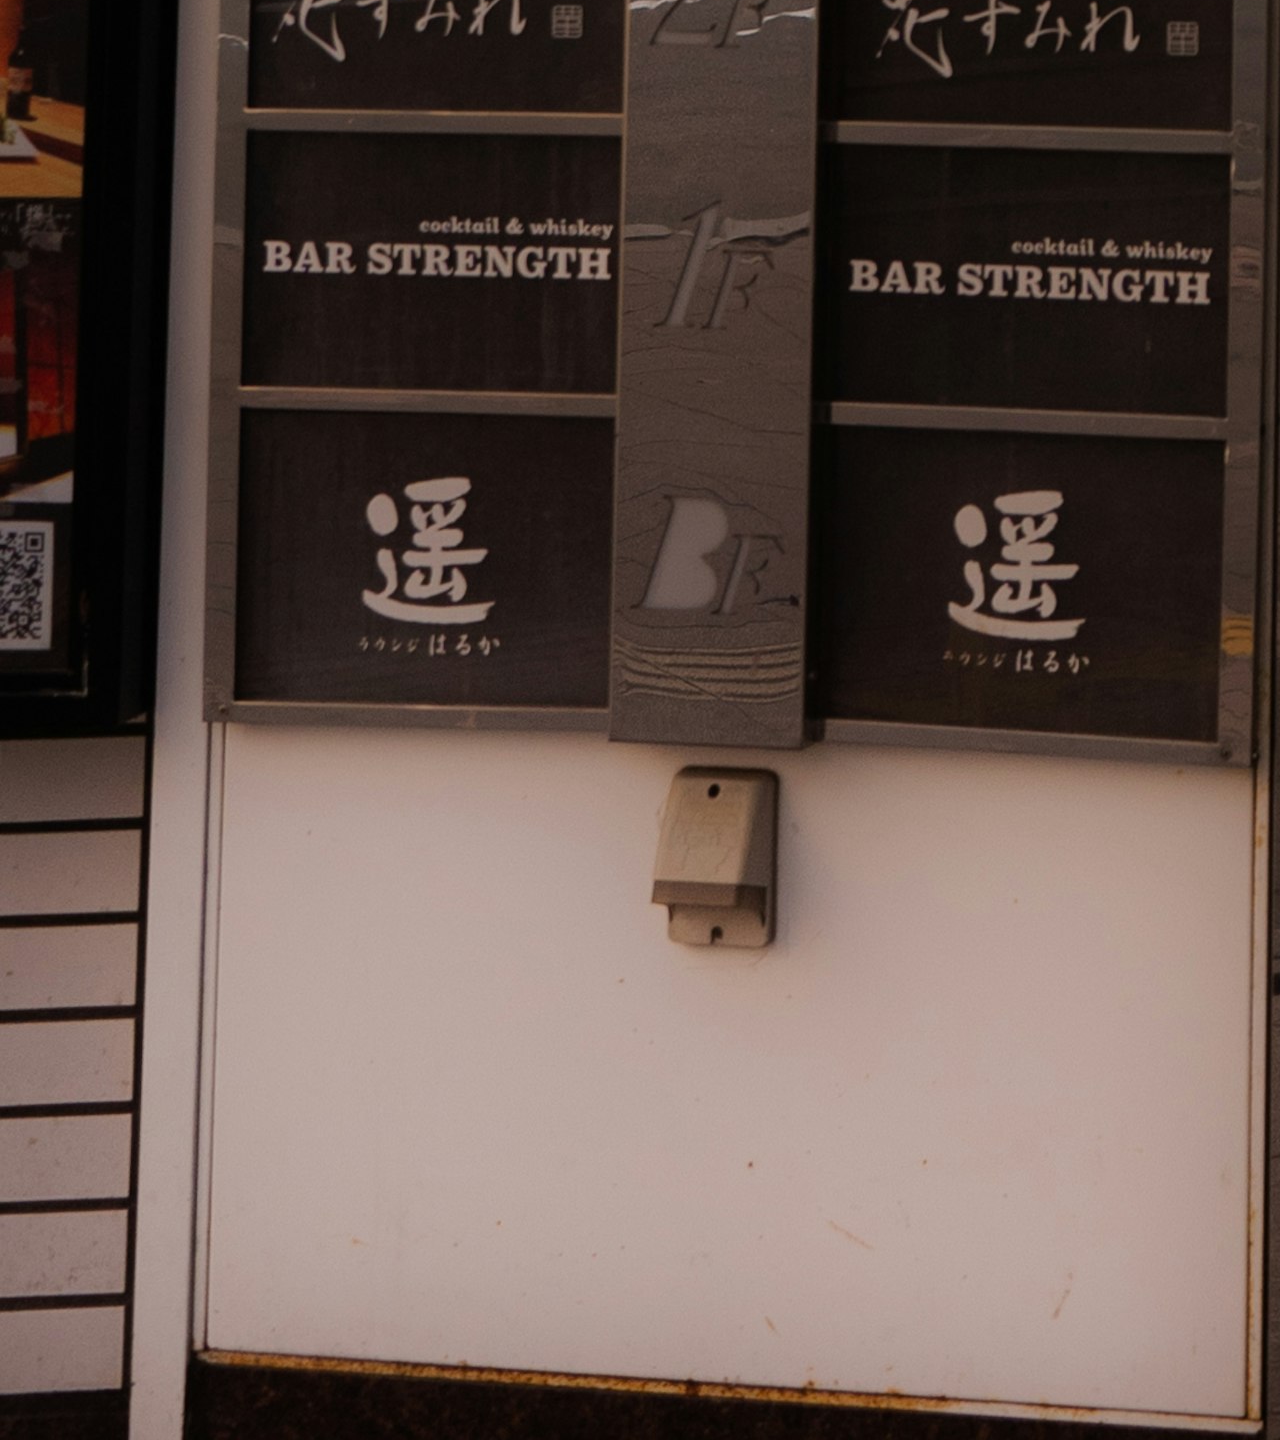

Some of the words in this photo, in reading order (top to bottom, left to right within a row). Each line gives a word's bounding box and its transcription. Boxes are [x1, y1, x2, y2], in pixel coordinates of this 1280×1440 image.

[419, 216, 500, 234] cocktail
[505, 217, 525, 235] &
[529, 218, 614, 241] whiskey
[262, 239, 357, 274] BAR
[367, 242, 613, 281] STRENGTH
[654, 199, 775, 329] 1F
[1011, 237, 1095, 257] cocktail
[1101, 239, 1121, 258] &
[1125, 240, 1214, 264] whiskey
[849, 259, 946, 295] BAR
[956, 262, 1212, 305] STRENGTH
[632, 493, 785, 616] BF
[429, 634, 500, 657] はるか
[1015, 649, 1090, 674] はるか
